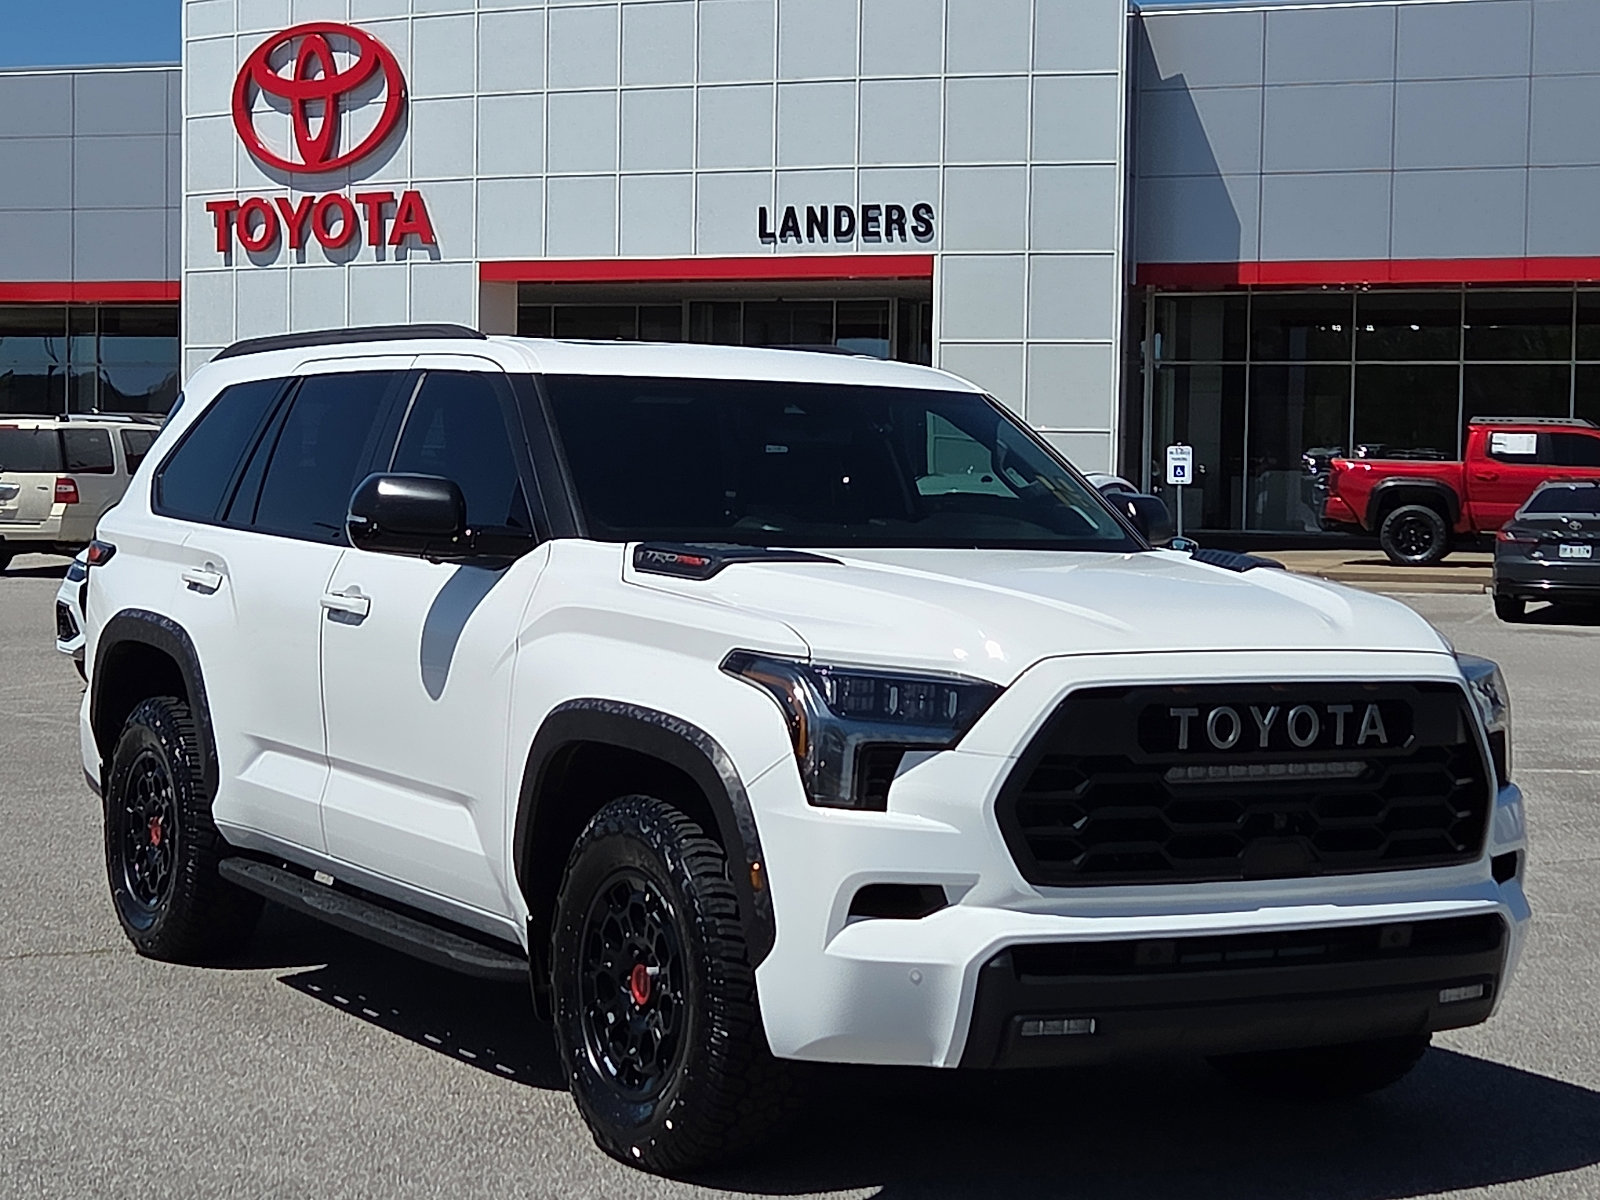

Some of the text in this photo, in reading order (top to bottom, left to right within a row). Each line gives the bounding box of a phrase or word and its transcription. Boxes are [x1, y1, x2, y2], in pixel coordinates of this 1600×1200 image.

[206, 191, 436, 252] TOYOTA
[758, 203, 935, 243] LANDERS
[1169, 703, 1388, 750] TOYOTA
